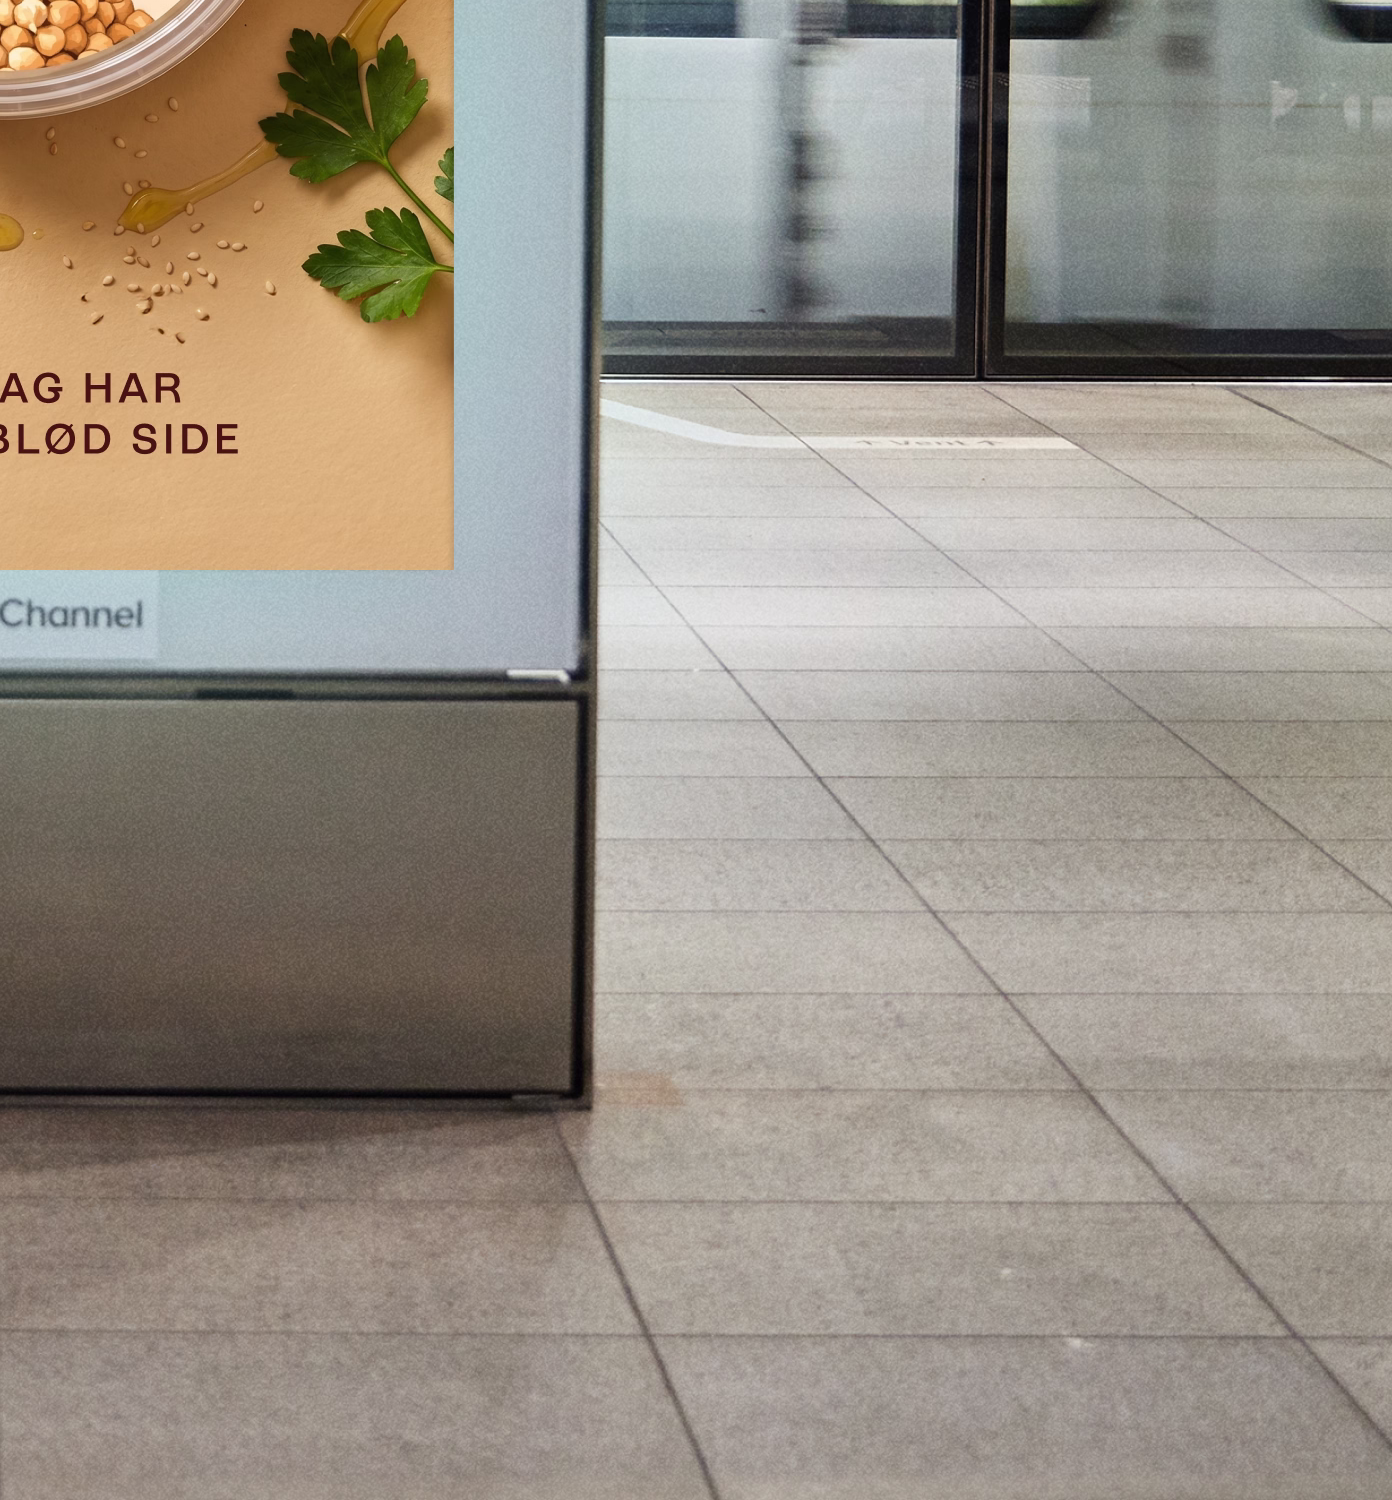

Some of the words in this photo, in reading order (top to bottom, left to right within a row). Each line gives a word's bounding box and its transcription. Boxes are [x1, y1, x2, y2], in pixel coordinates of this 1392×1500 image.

[85, 372, 182, 404] HAR
[132, 423, 240, 456] SIDE
[0, 598, 144, 629] Channel
